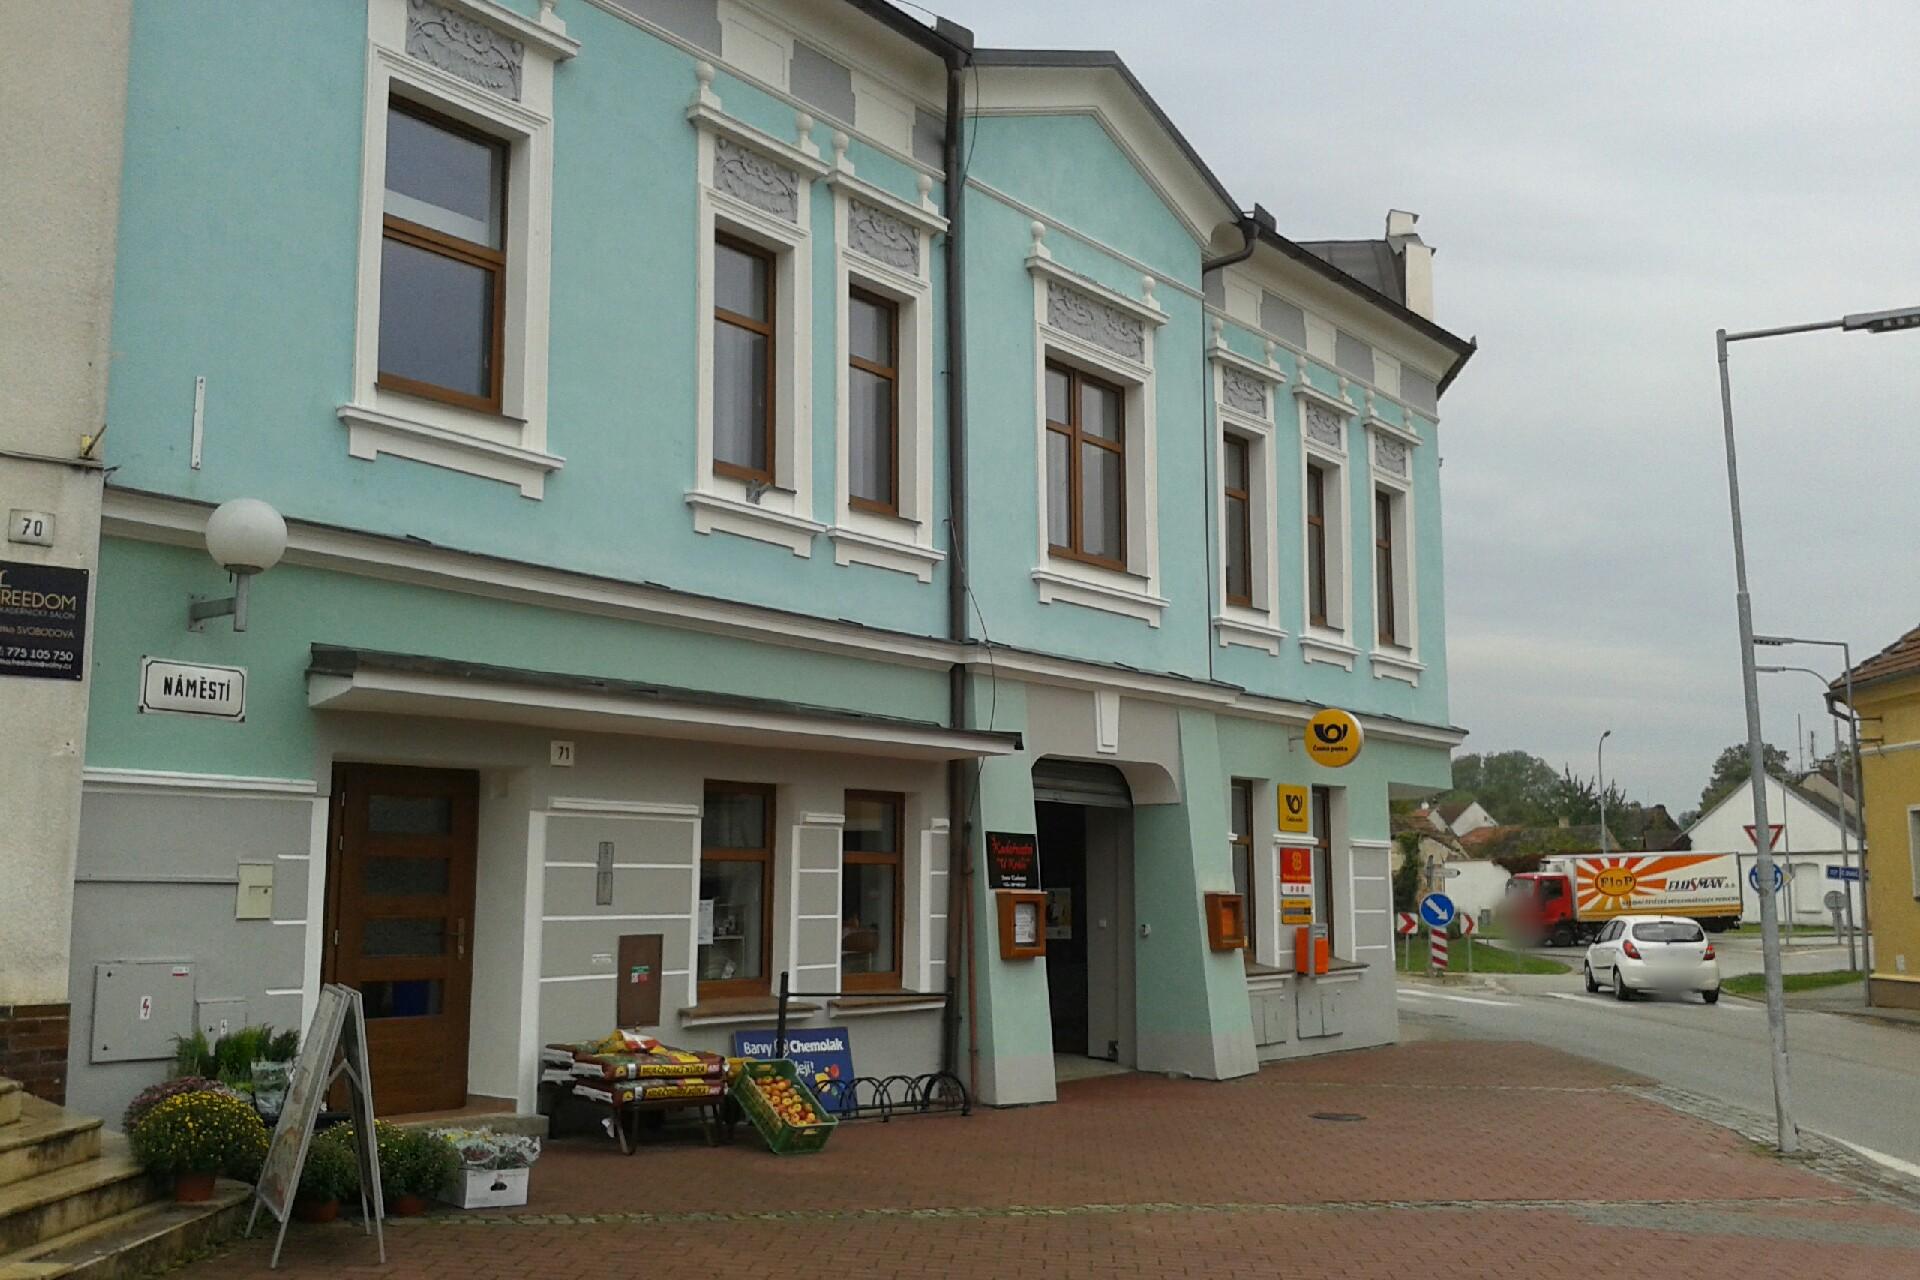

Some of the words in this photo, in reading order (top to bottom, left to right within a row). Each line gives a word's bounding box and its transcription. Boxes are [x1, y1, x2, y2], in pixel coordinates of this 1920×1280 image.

[22, 517, 43, 537] 70
[0, 588, 77, 611] REEDOM
[17, 625, 75, 639] SVOBODOVÁ
[163, 674, 231, 702] NÁMĚSTÍ
[557, 745, 570, 760] 71
[743, 1041, 773, 1057] Barvy
[789, 1038, 844, 1054] Chemolak
